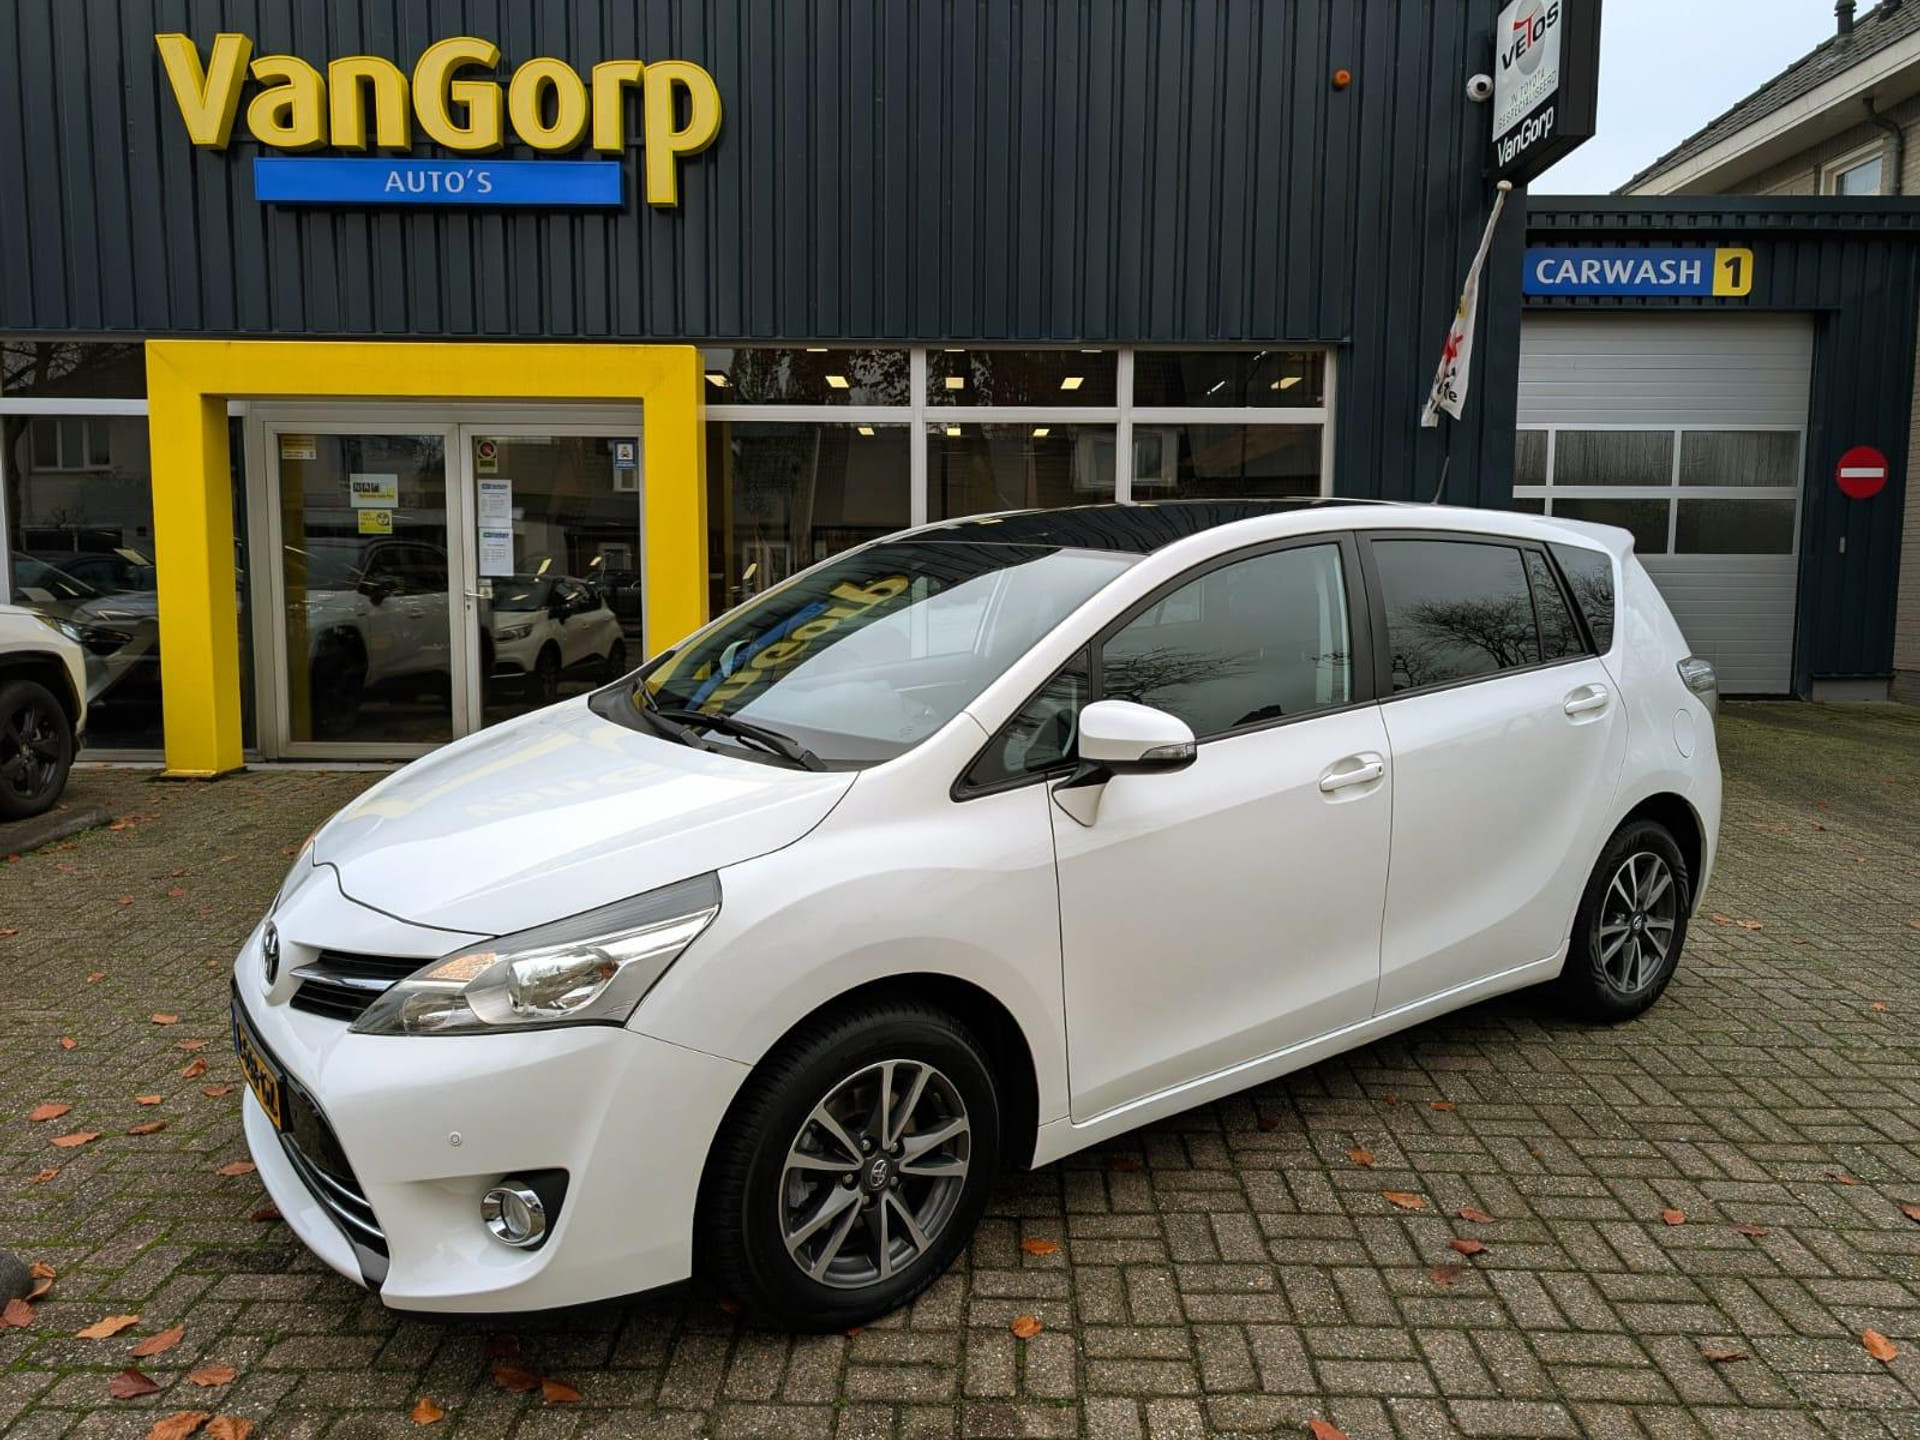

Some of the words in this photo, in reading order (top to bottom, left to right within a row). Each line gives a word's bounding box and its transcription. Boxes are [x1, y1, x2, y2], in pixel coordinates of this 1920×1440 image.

[1501, 2, 1559, 70] VETOS
[1520, 67, 1546, 98] TOYOTA
[156, 33, 722, 208] VanGorp
[1497, 106, 1555, 168] VanGorp
[384, 170, 493, 195] AUTO'S
[1536, 258, 1701, 285] CARWASH
[1724, 256, 1742, 288] 1
